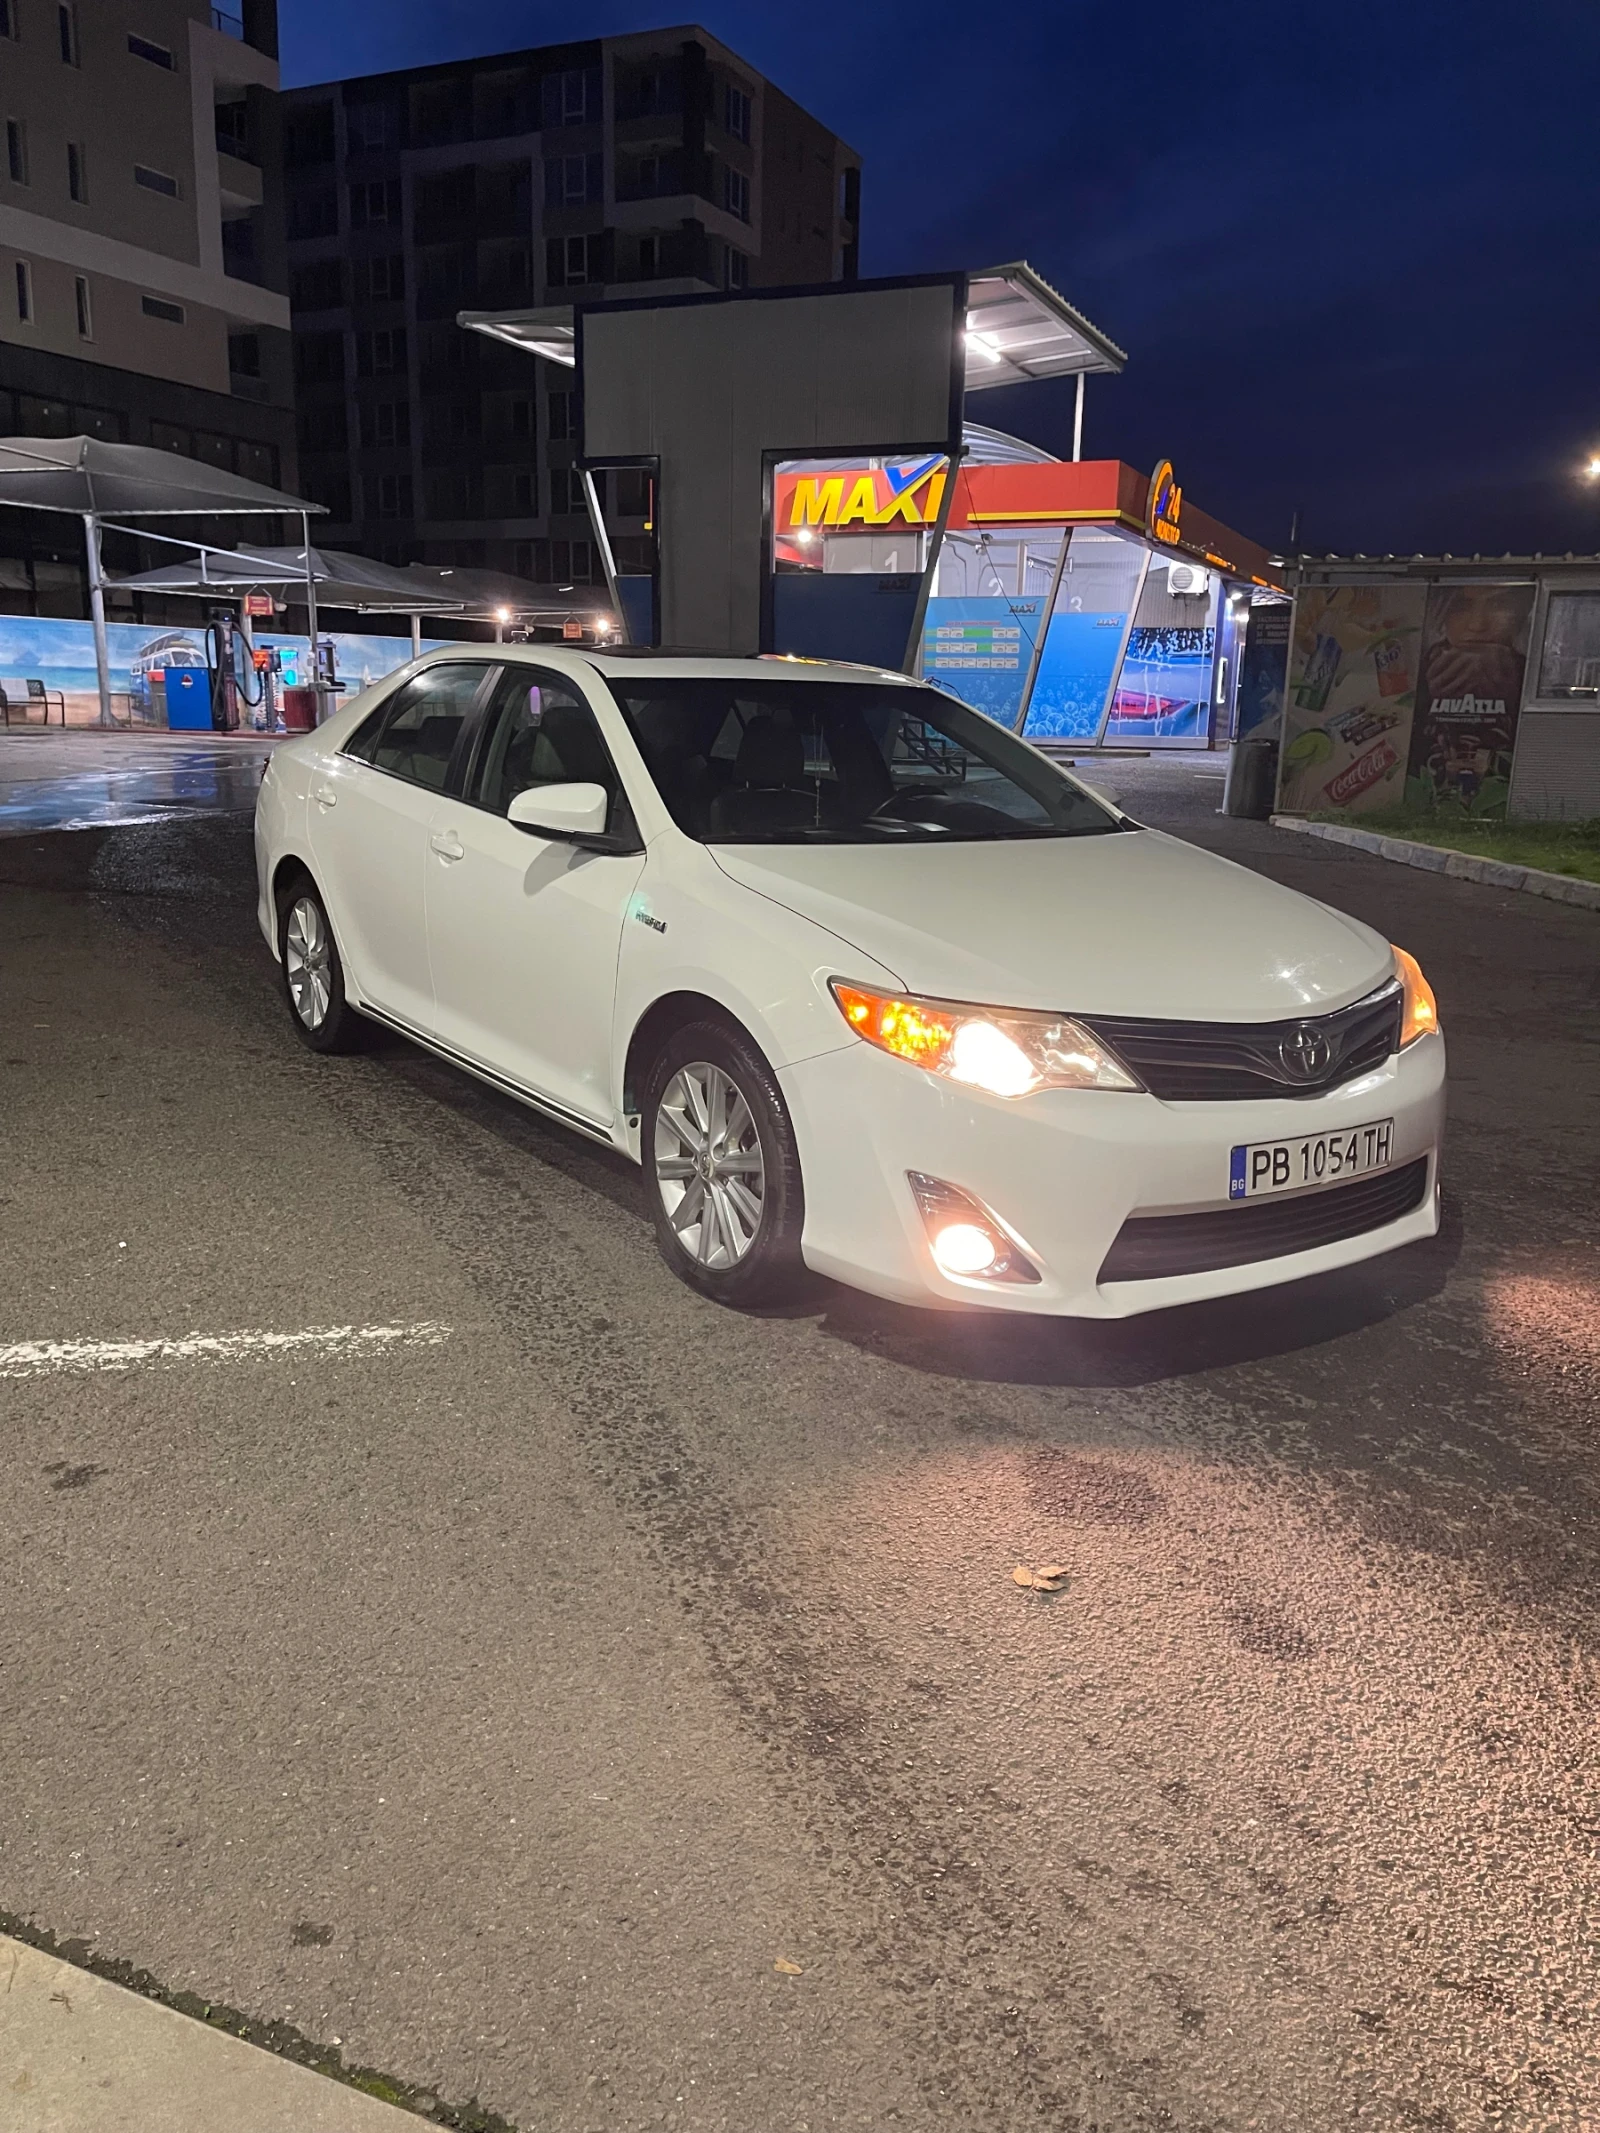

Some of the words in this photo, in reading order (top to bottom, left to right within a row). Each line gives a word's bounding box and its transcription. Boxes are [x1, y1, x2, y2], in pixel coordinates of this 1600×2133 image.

[789, 453, 949, 526] MAXI
[884, 551, 898, 573] 1
[988, 577, 1004, 596] 2
[1009, 601, 1039, 614] MAXI
[1096, 615, 1123, 626] MAXI
[1430, 693, 1506, 714] LAVAZZA
[1252, 1147, 1290, 1190] PB
[1300, 1134, 1358, 1181] 1054
[1363, 1125, 1390, 1167] TH
[1231, 1178, 1245, 1191] BG
